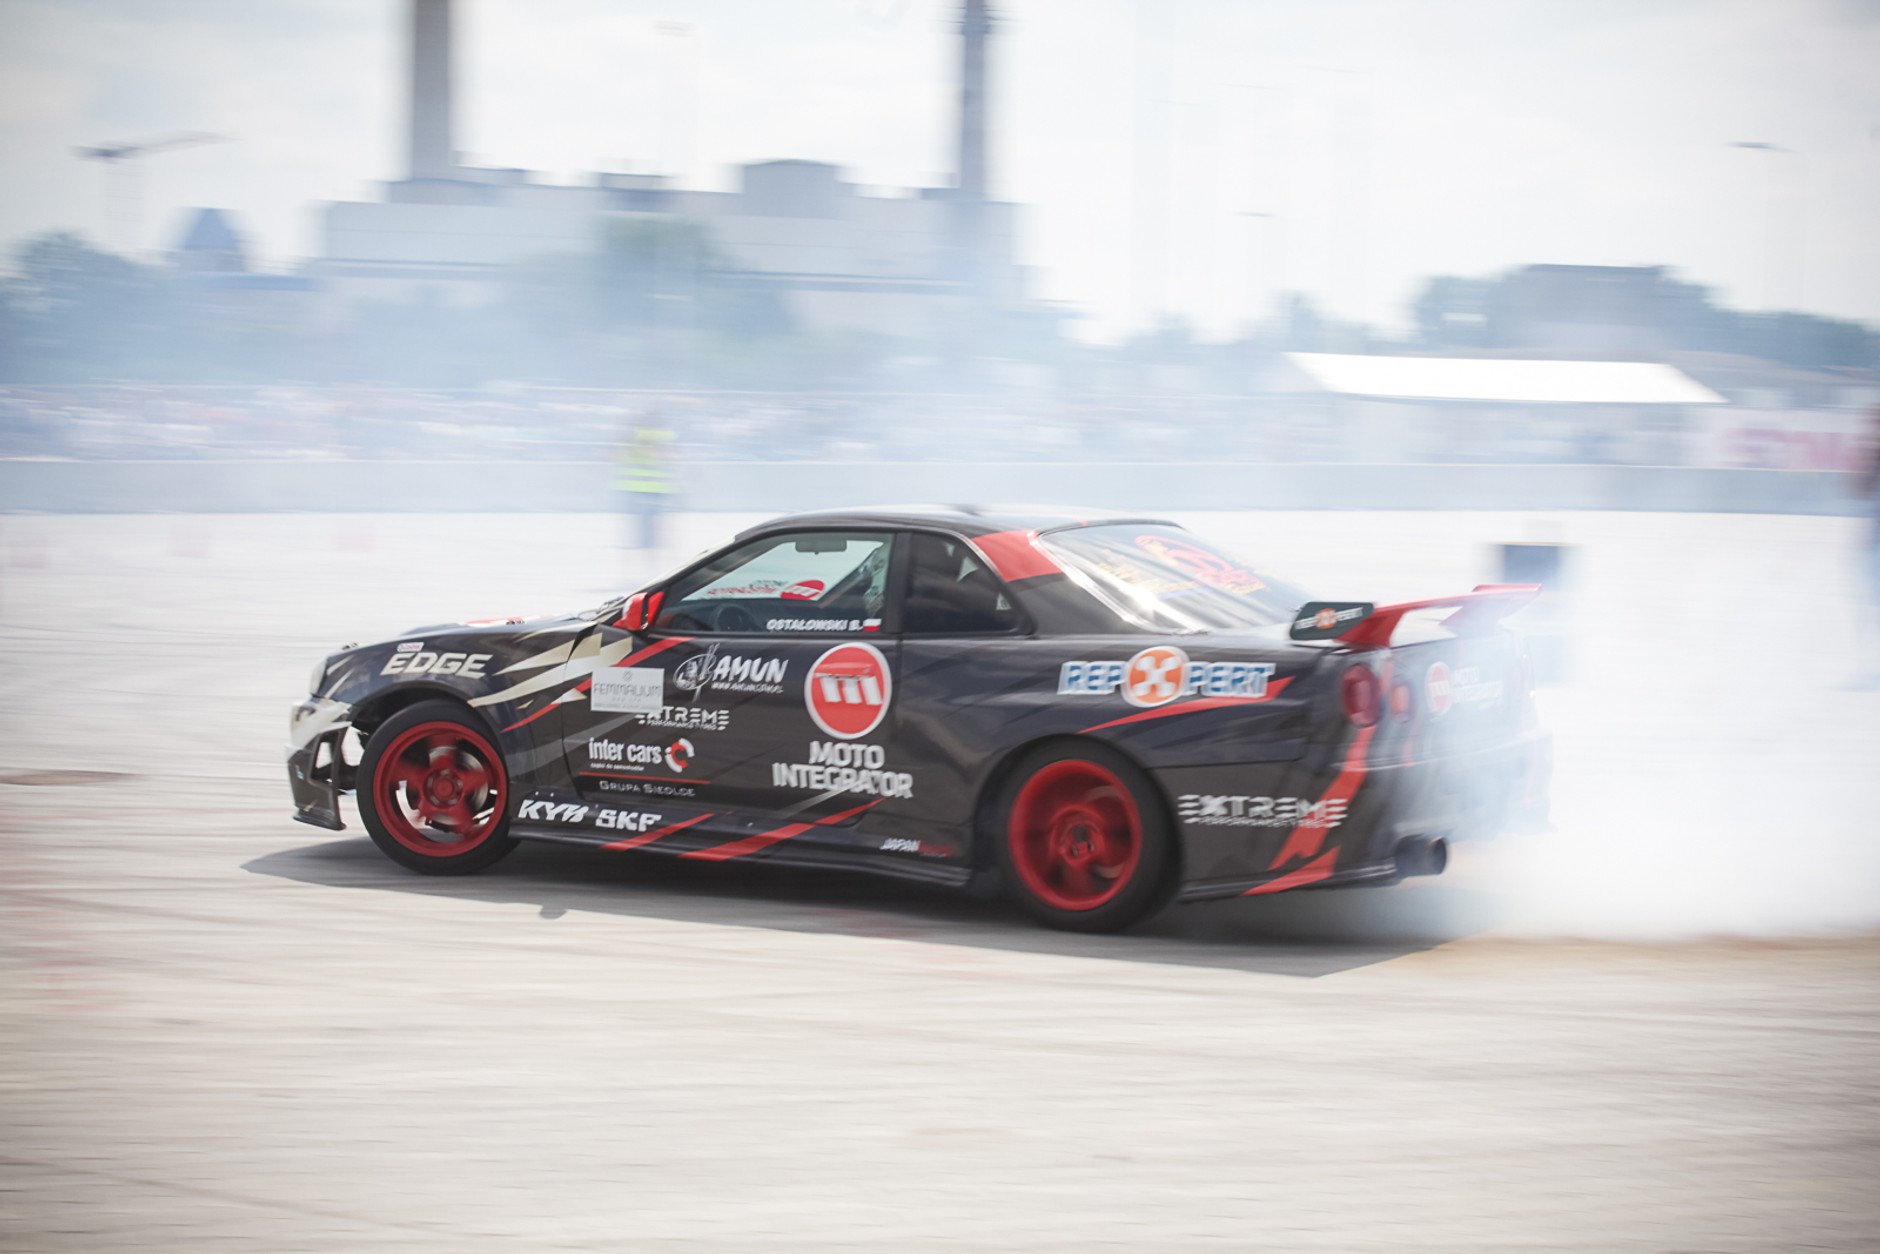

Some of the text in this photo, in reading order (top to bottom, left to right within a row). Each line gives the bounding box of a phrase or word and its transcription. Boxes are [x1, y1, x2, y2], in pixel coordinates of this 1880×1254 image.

[380, 652, 493, 680] EDGE
[712, 655, 789, 683] AMUN
[1057, 645, 1276, 707] REPXPERT
[589, 737, 662, 764] inter cars
[809, 740, 885, 770] MOTO
[772, 762, 914, 799] INTEGRATOR
[518, 799, 662, 832] KYB SKF
[1178, 794, 1348, 827] EXTREME
